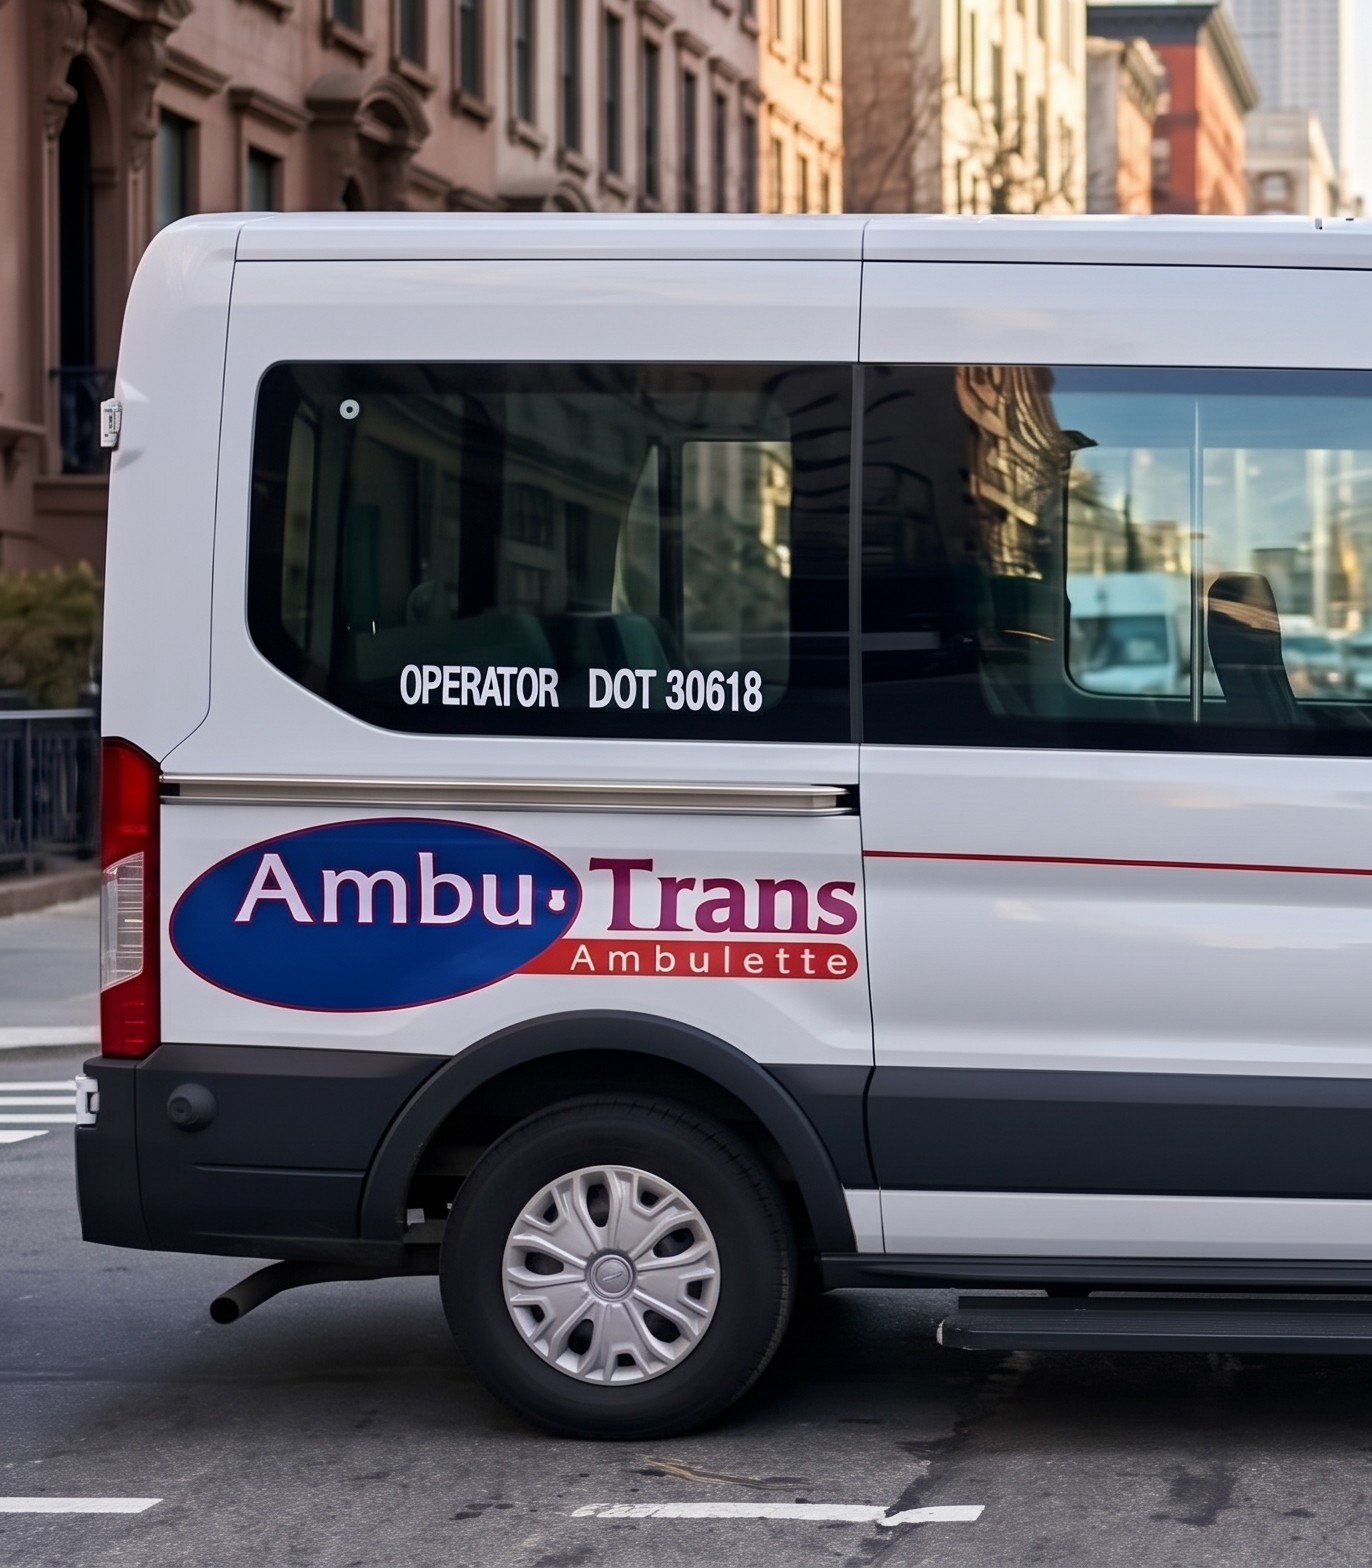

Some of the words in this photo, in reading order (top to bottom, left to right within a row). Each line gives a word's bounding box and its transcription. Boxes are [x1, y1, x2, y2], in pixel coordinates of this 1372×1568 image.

[400, 664, 560, 708] OPERATOR
[589, 668, 657, 710] DOT
[665, 669, 763, 712] 30618
[589, 857, 858, 935] Trans
[570, 944, 848, 975] Ambulette
